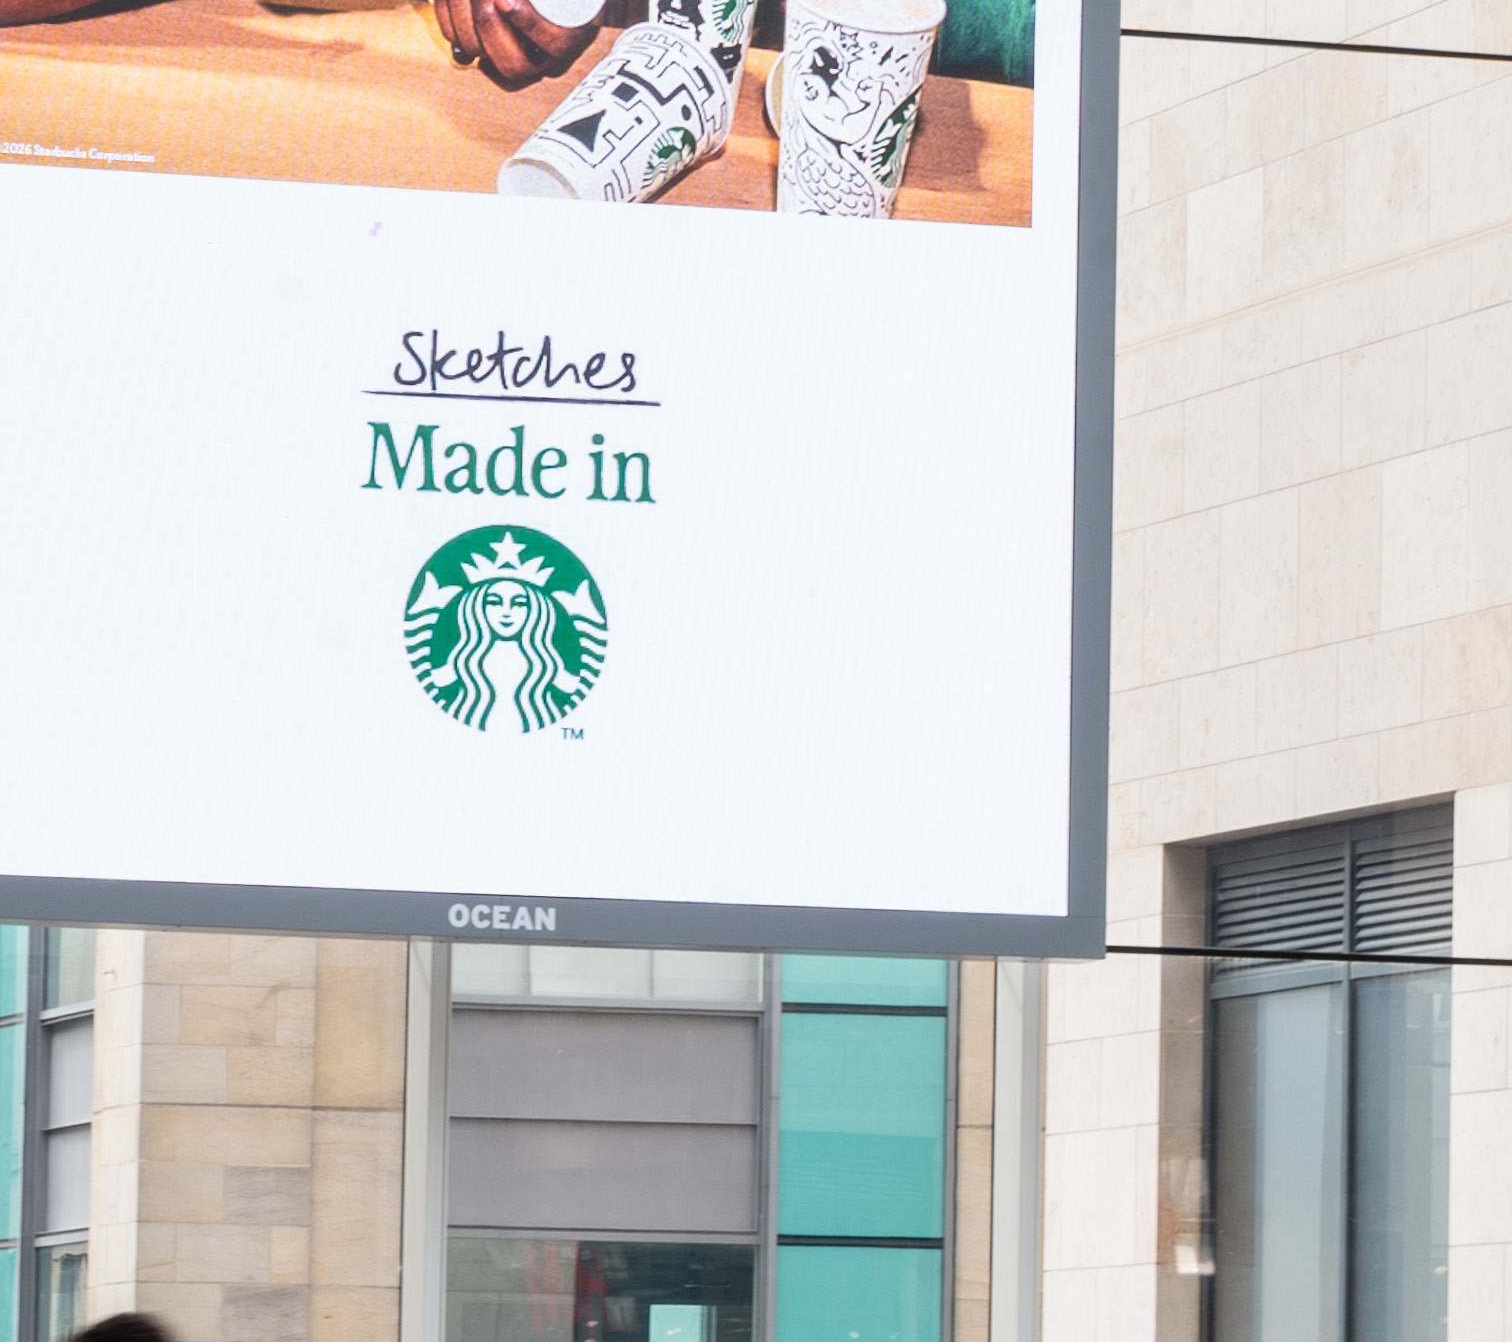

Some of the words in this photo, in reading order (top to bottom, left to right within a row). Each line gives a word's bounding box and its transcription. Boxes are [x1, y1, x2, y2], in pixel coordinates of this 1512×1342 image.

[34, 144, 87, 158] Starbucks
[89, 148, 155, 163] Corporation
[394, 329, 637, 393] Sketches
[361, 422, 567, 500] Made
[587, 434, 656, 504] in
[449, 904, 557, 931] OCEAN
